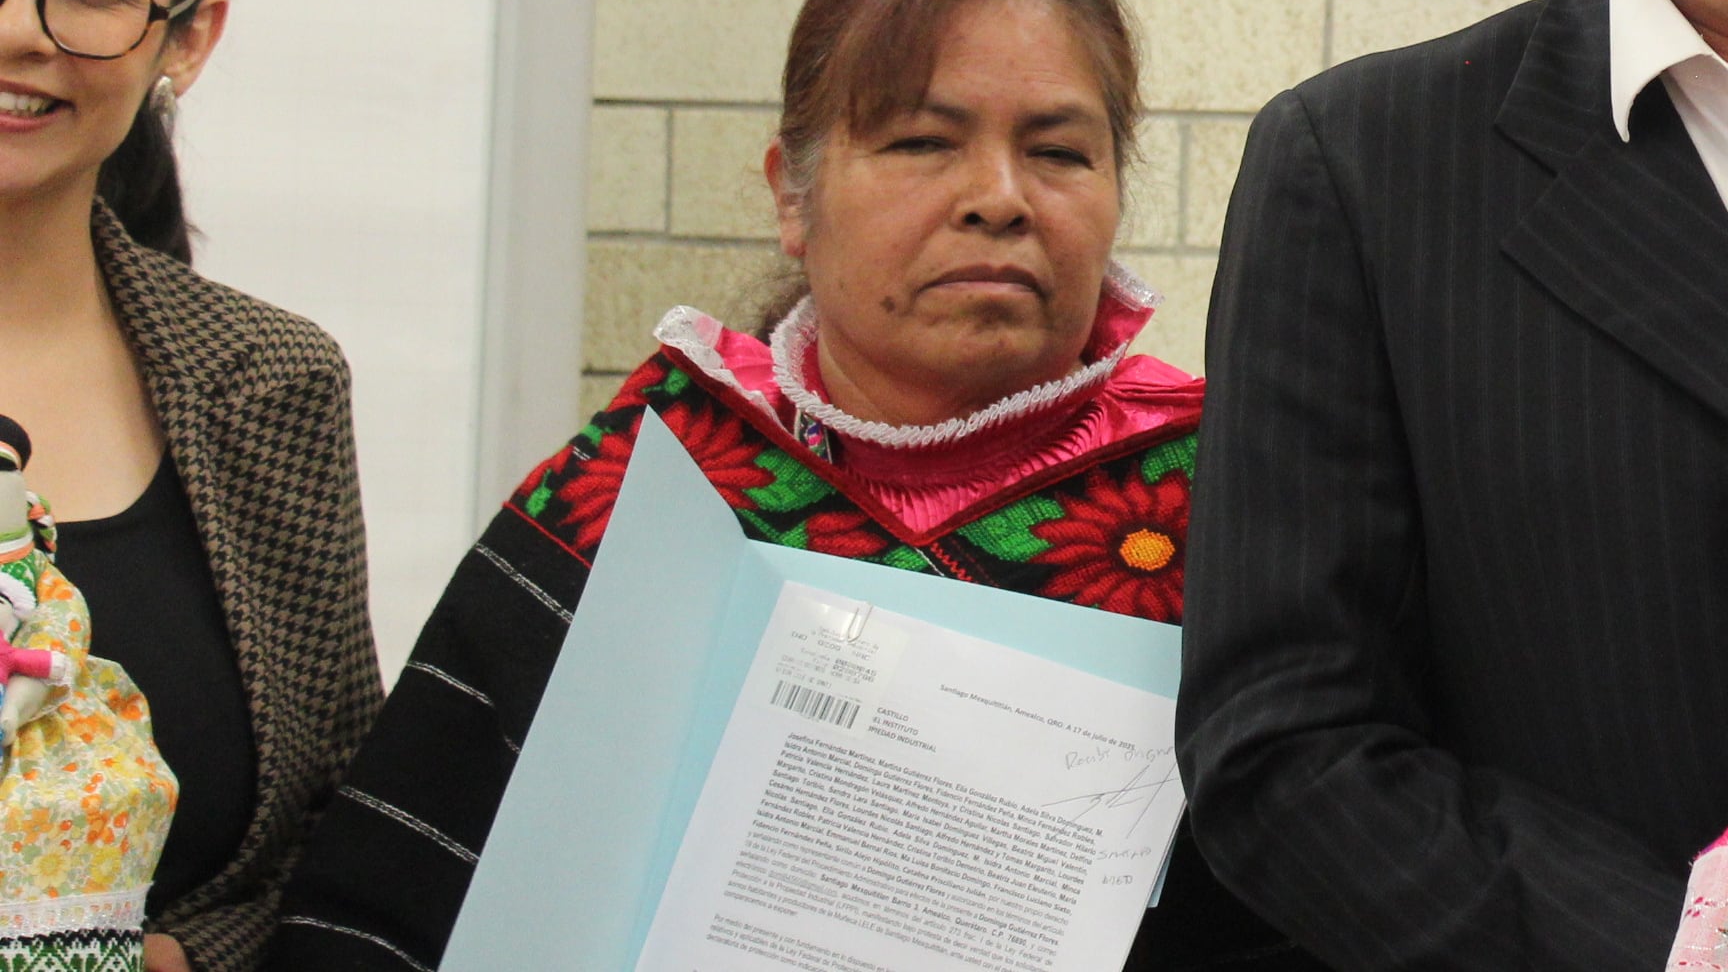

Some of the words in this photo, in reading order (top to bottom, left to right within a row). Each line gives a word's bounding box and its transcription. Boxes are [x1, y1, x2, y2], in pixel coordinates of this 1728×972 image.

[876, 706, 909, 721] CASTILLO
[881, 719, 919, 736] INSTITUTO
[895, 734, 938, 753] INDUSTRIAL
